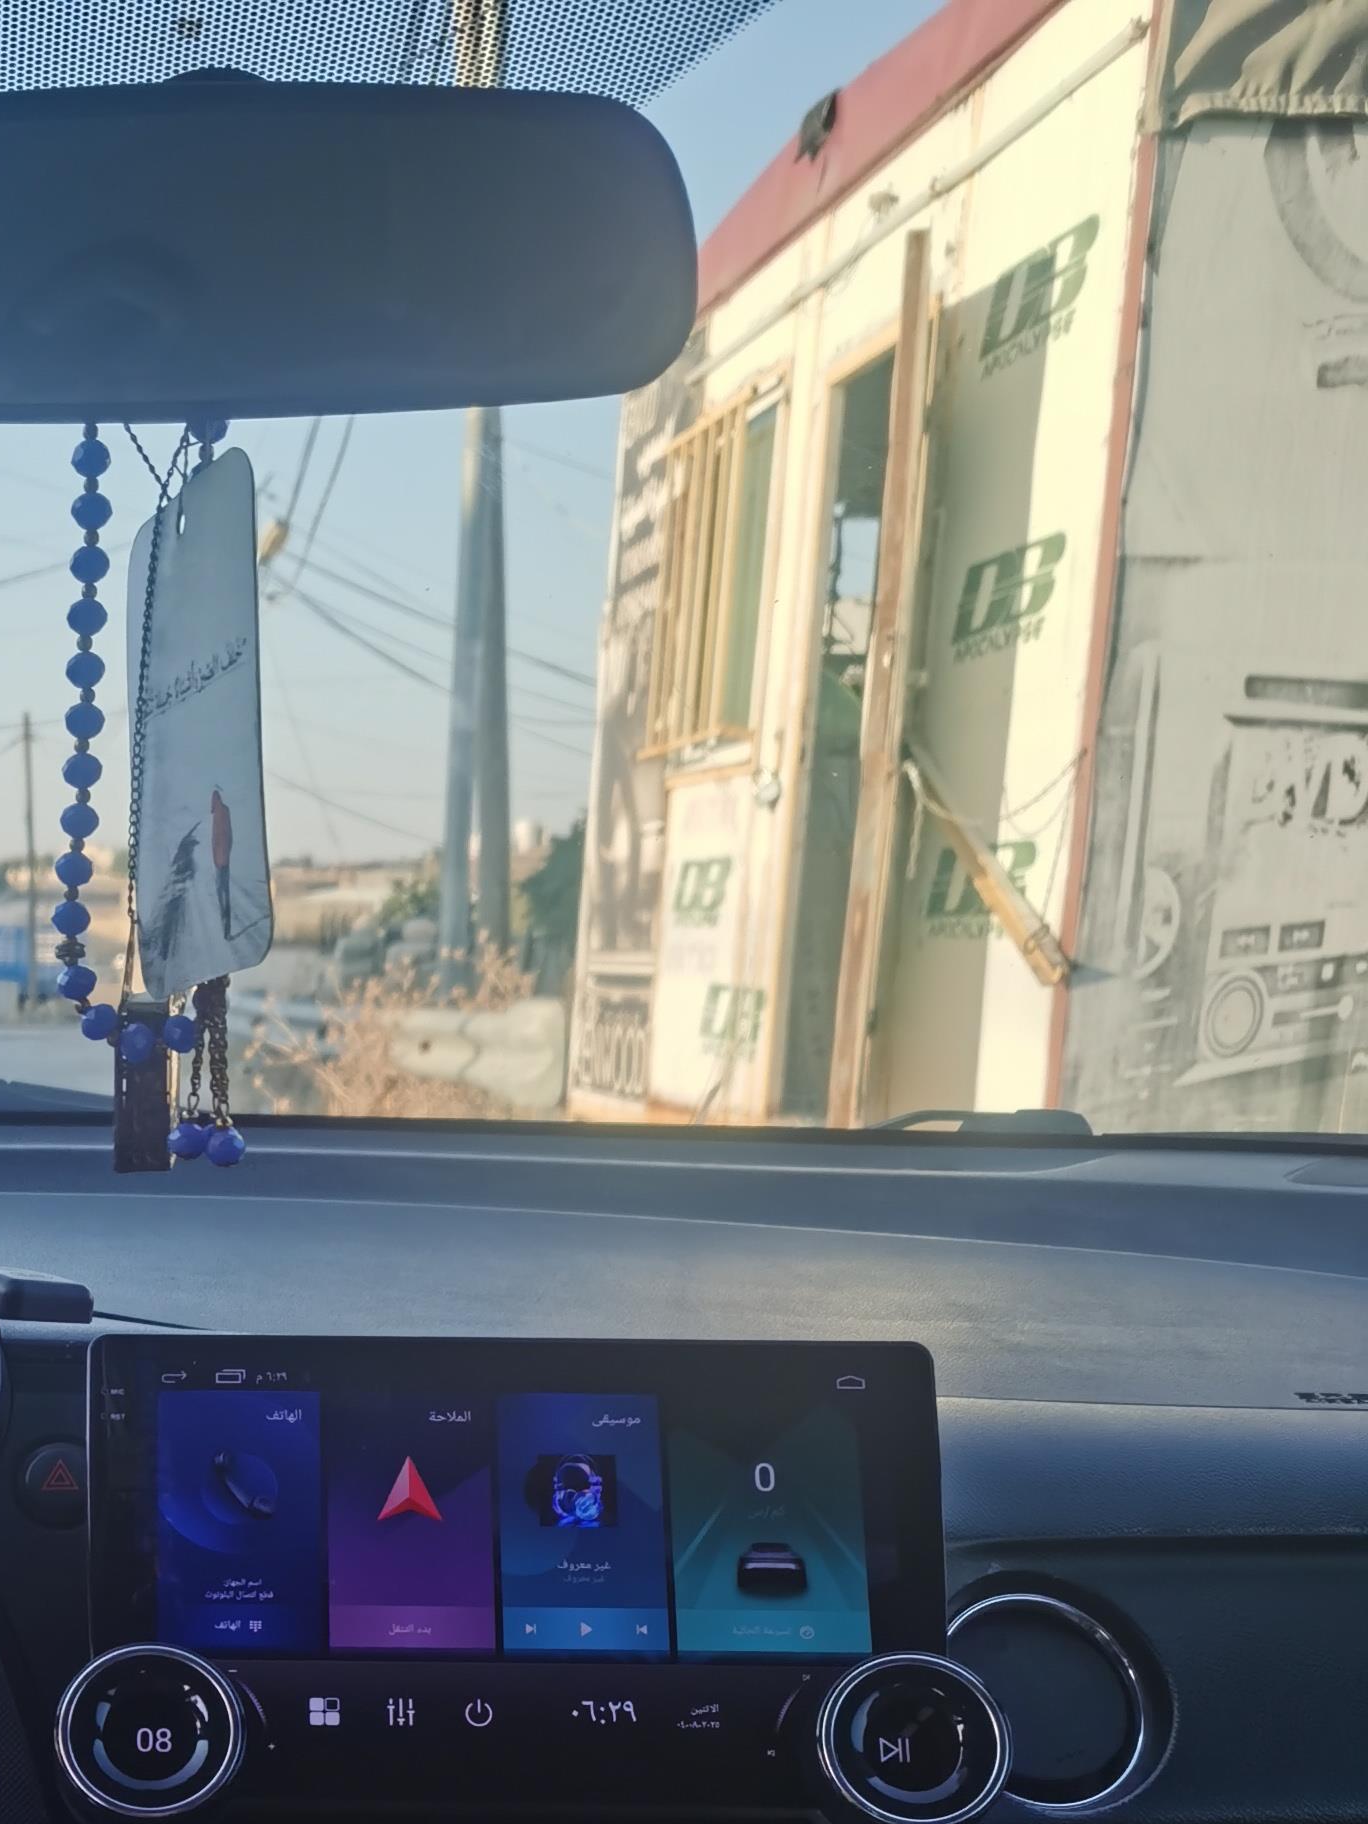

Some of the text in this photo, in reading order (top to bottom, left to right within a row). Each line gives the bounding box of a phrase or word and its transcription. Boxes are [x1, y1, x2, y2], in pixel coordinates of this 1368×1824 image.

[265, 1408, 302, 1424] الهاتف
[428, 1410, 472, 1423] الملاحة
[591, 1413, 641, 1428] موسيقى
[754, 1462, 776, 1492] 0
[557, 1559, 612, 1571] غير معروف
[214, 1619, 241, 1631] الهاتف
[572, 1700, 637, 1725] ٠٦:٢٩
[136, 1727, 173, 1753] 08
